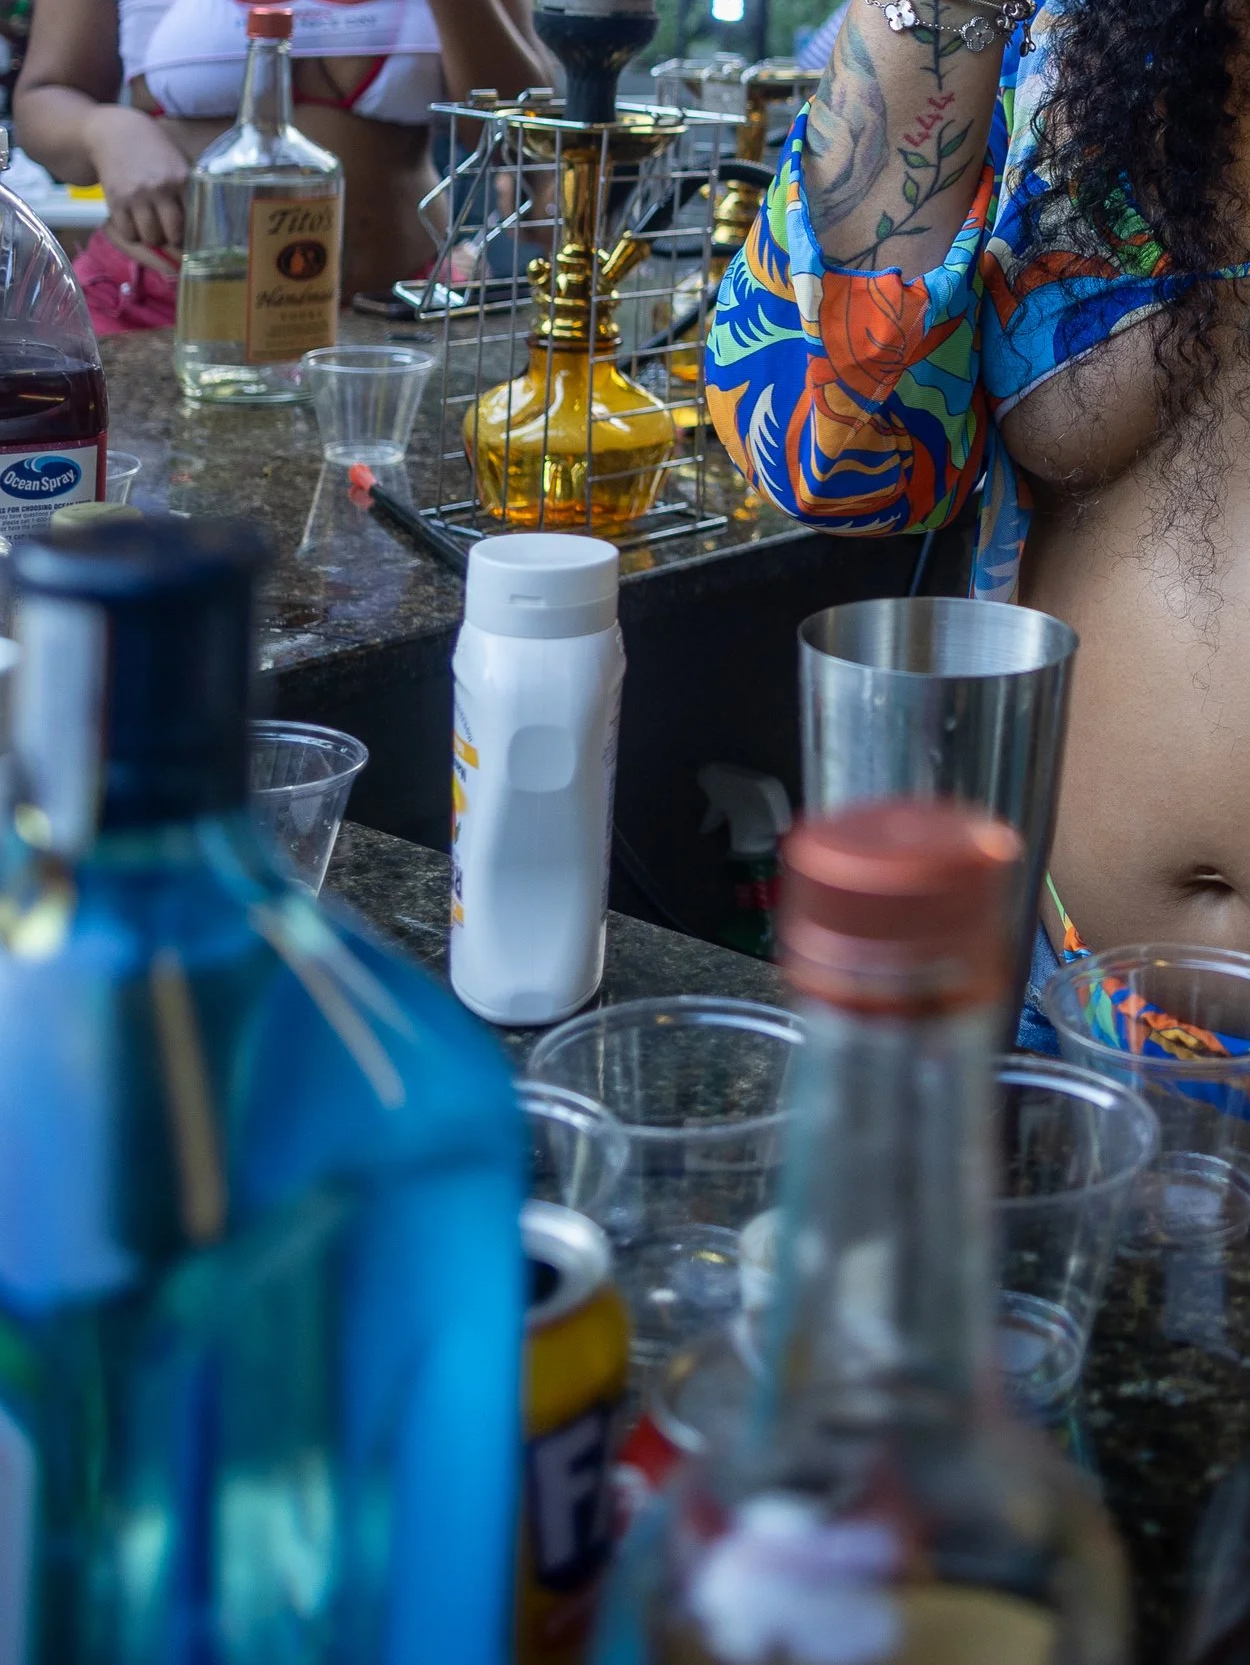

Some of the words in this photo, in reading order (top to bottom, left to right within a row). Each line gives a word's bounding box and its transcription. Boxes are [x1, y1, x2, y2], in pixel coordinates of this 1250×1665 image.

[903, 91, 956, 147] 444
[268, 207, 334, 235] Tito's
[3, 470, 40, 491] Ocean
[40, 469, 76, 492] Spray
[21, 503, 52, 512] CHOOSING
